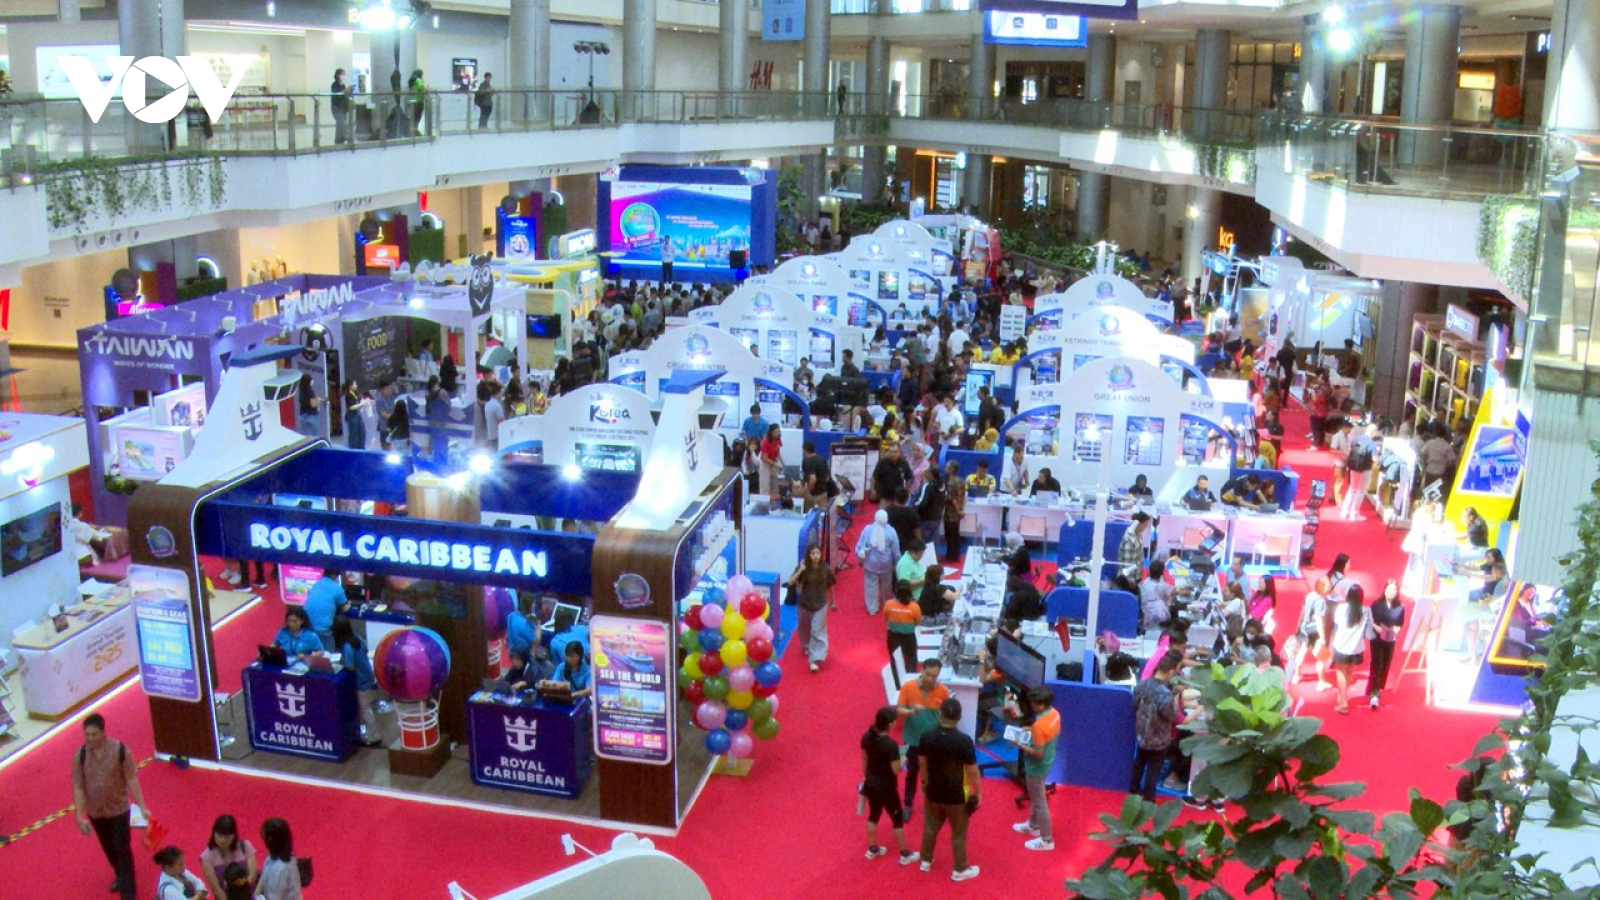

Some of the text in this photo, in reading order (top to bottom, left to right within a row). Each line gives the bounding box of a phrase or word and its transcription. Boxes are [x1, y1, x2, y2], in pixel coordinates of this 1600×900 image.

[280, 281, 352, 317] TAIWAN
[85, 332, 194, 360] TAIWAN
[366, 333, 387, 351] FOOD
[1094, 393, 1151, 403] GREAT UNION
[589, 404, 631, 423] Korea
[250, 522, 547, 578] ROYAL CARIBBEAN
[600, 669, 615, 680] SEA
[618, 671, 631, 682] THE
[634, 672, 661, 685] WORLD
[275, 721, 315, 737] ROYAL
[260, 731, 333, 752] CARIBBEAN
[500, 756, 545, 773] ROYAL
[484, 766, 566, 788] CARIBBEAN
